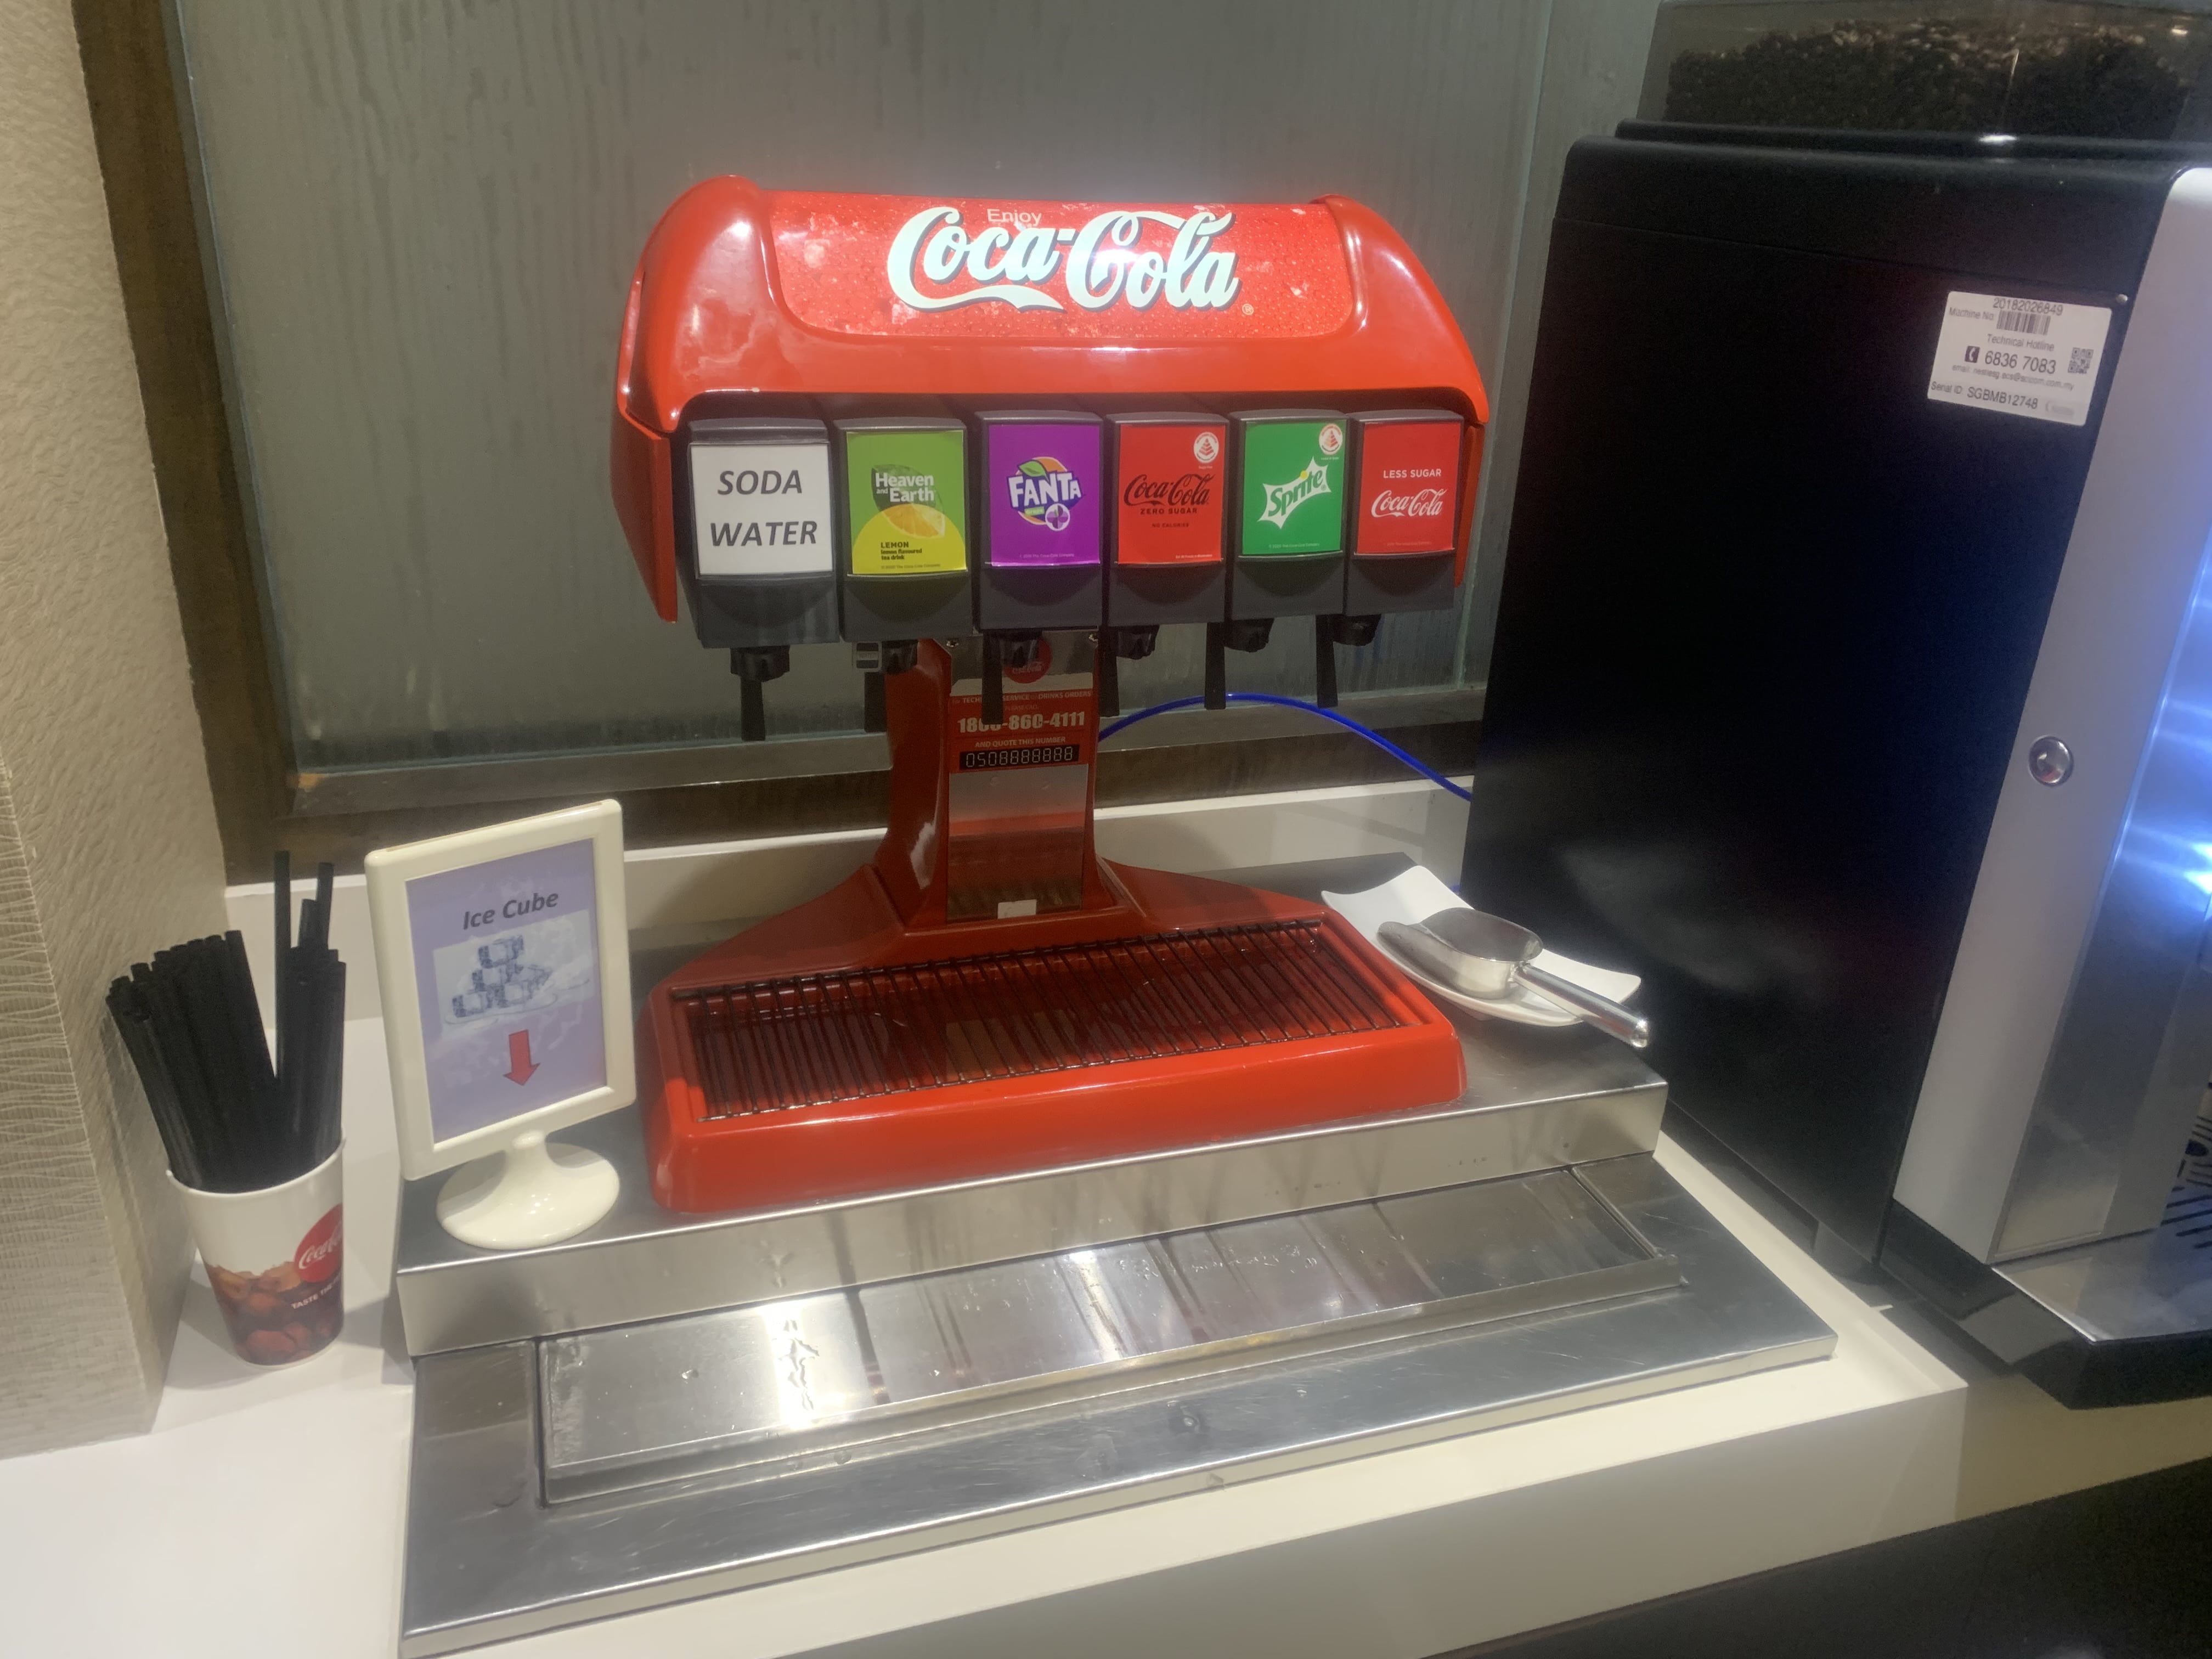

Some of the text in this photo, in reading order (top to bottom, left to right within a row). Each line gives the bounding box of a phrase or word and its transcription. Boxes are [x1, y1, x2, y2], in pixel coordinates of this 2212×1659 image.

[987, 208, 1042, 226] Enjoy
[887, 206, 1243, 313] Coca-Cola
[1948, 307, 1980, 320] Machine
[1987, 334, 2055, 352] Technical Hotline
[1984, 350, 2057, 374] 6836 7083
[1931, 381, 1952, 394] Serial
[1967, 387, 2038, 409] SGBMB12748
[718, 470, 802, 495] SODA
[875, 472, 934, 488] Heaven
[1383, 469, 1441, 478] LESS SUGAR
[889, 487, 934, 503] Earth
[1008, 472, 1082, 508] FANTA
[1123, 473, 1216, 506] Coca-Cola
[1268, 470, 1324, 517] Sprite
[1371, 488, 1448, 518] Coca-Cola
[710, 521, 817, 547] WATER
[463, 893, 559, 930] Ice Cube
[290, 1293, 318, 1310] TASTE
